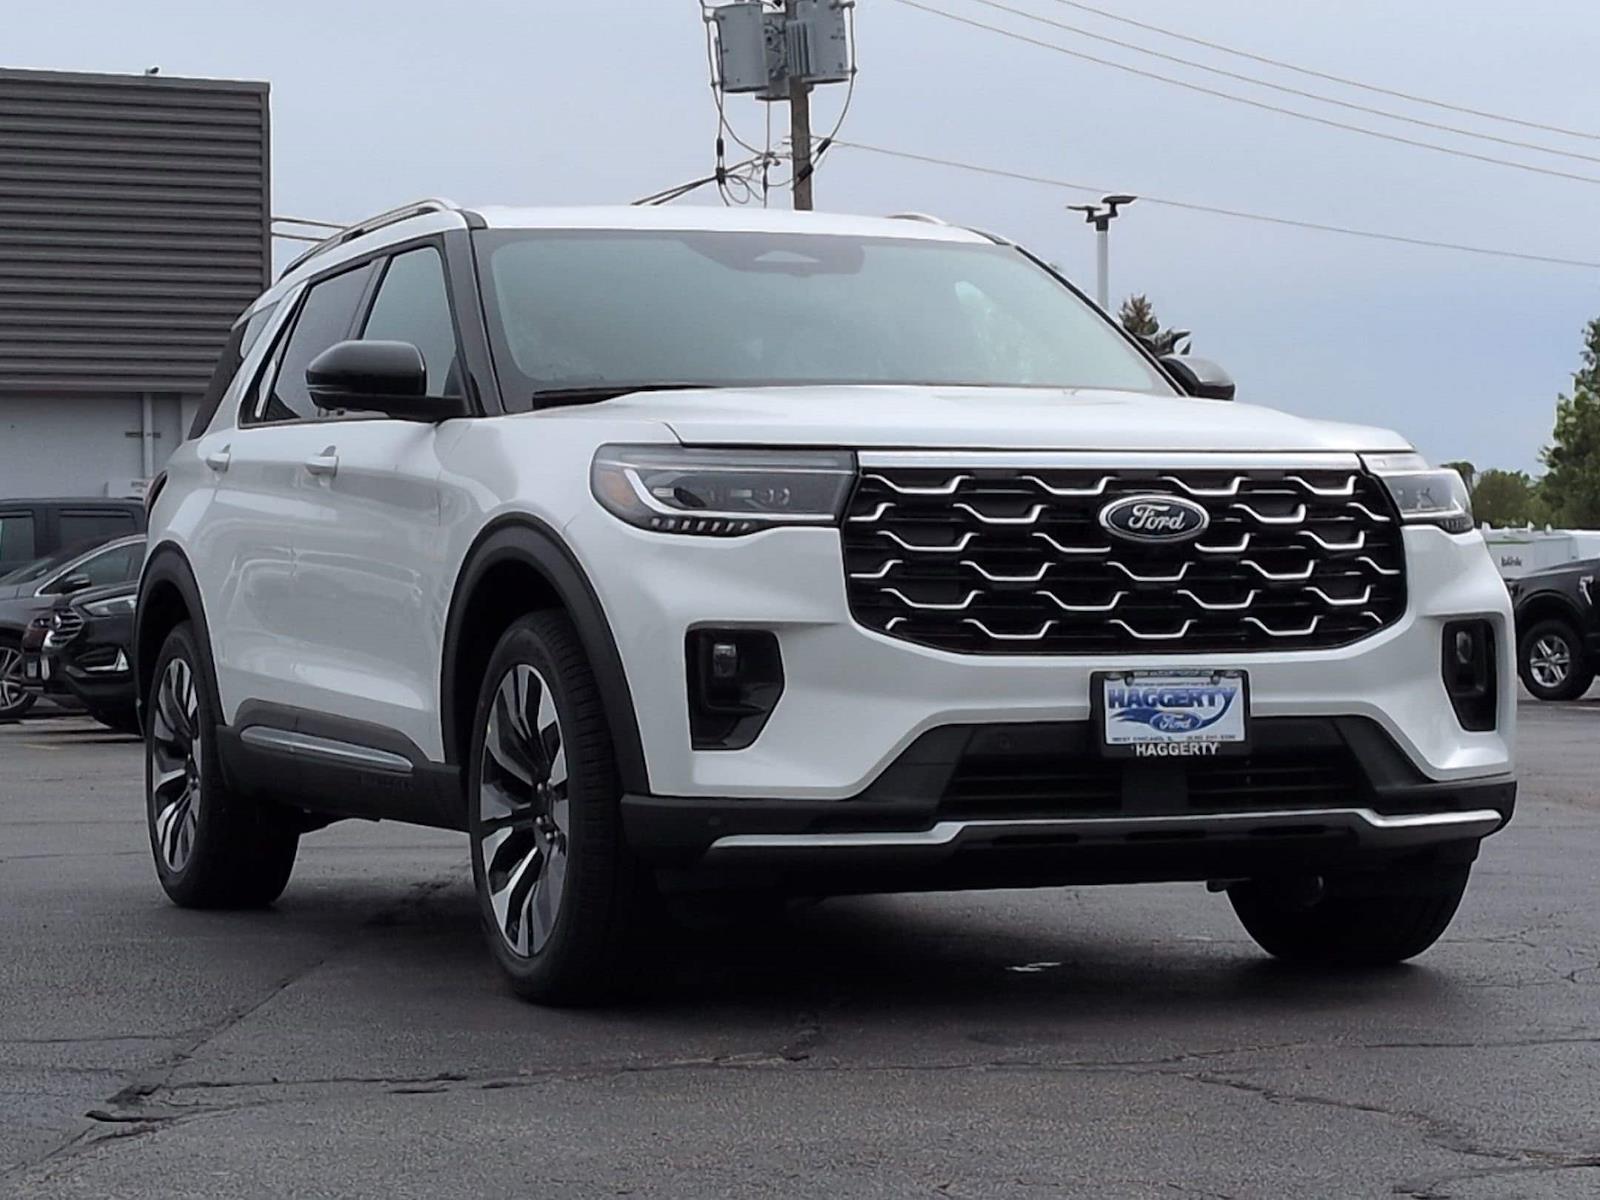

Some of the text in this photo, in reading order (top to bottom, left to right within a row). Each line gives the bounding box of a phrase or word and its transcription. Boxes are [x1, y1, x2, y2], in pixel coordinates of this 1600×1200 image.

[1128, 504, 1185, 530] Ford
[1108, 688, 1237, 709] HAGGERTY
[1159, 714, 1191, 729] Ford
[1136, 742, 1218, 757] HAGGERTY
